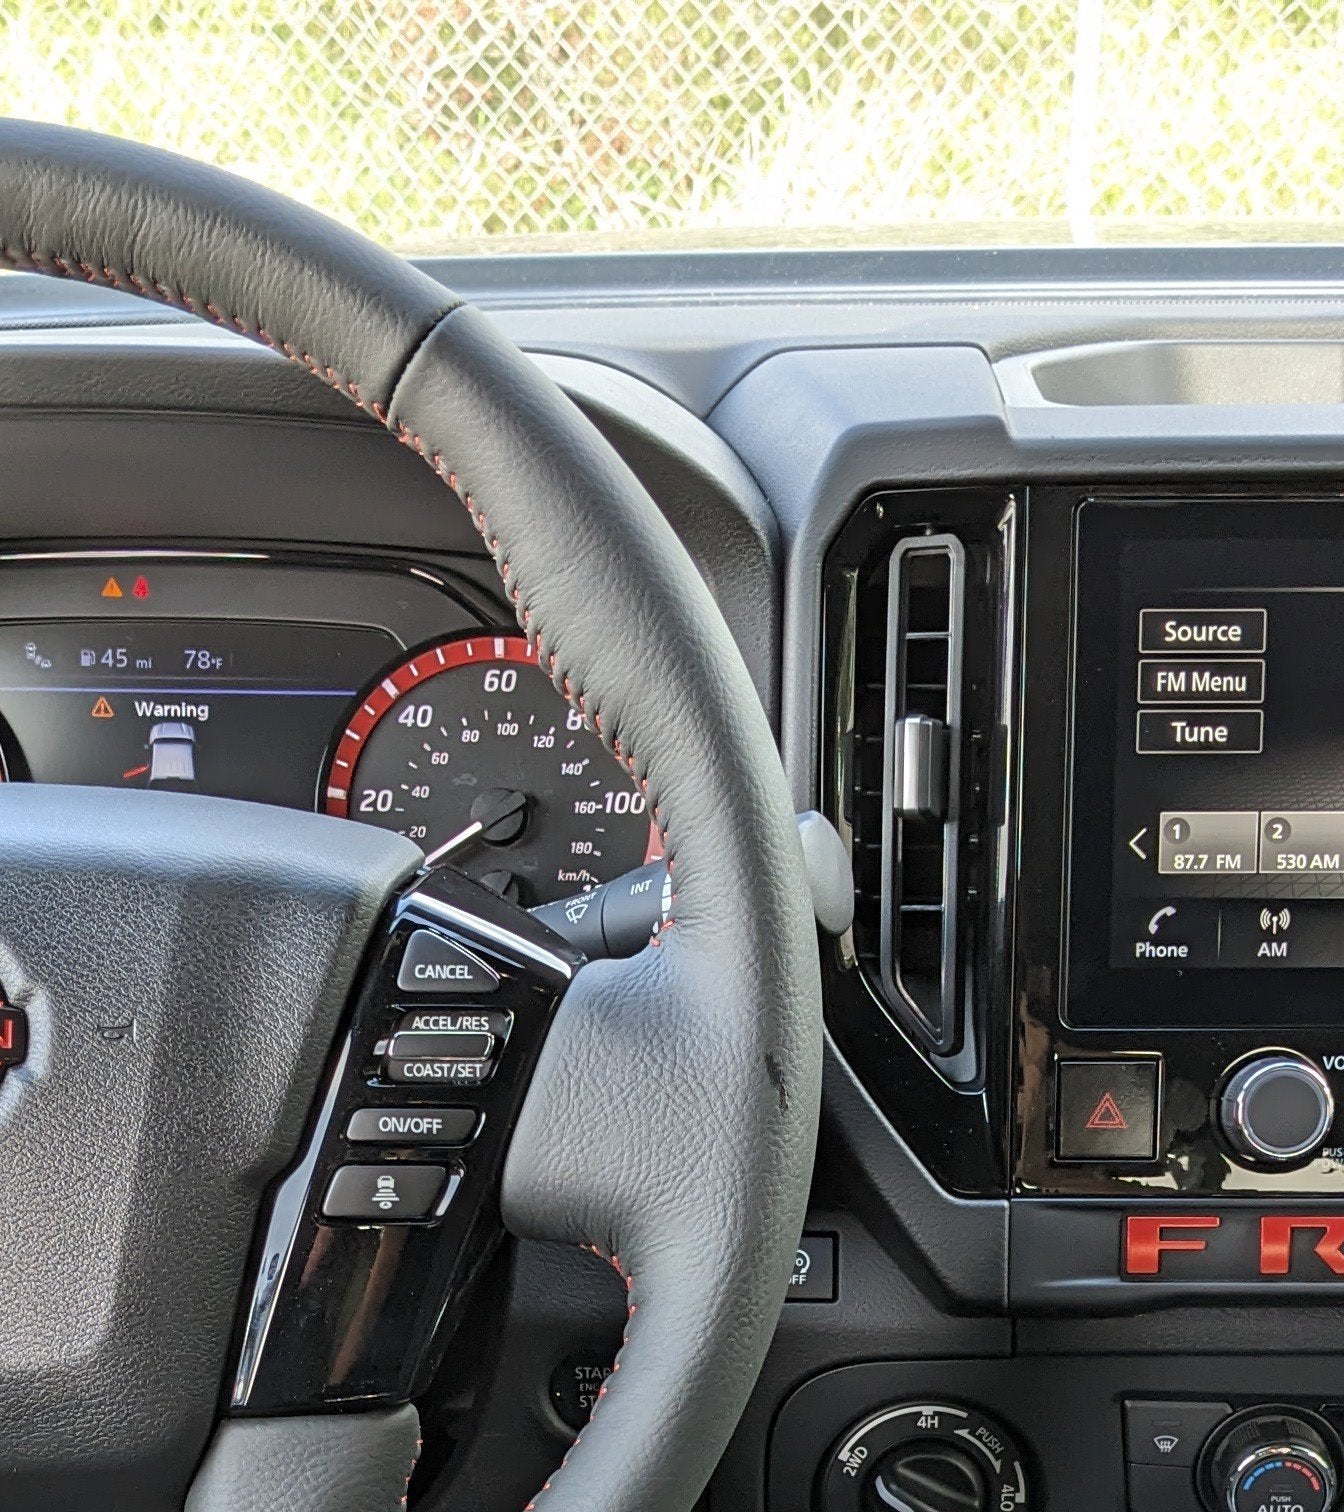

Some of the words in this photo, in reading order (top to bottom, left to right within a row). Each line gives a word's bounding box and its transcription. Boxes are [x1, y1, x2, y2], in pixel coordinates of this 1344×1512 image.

[1164, 621, 1242, 643] Source
[100, 648, 128, 669] 45
[483, 669, 517, 693] 60
[1156, 672, 1187, 693] FM
[1191, 672, 1247, 693] Menu
[134, 700, 210, 721] Warning
[398, 704, 433, 728] 40
[461, 729, 480, 743] 80
[496, 722, 519, 737] 100
[1171, 722, 1229, 743] Tune
[532, 735, 555, 749] 120
[430, 752, 449, 765] 60
[560, 762, 584, 777] 140
[411, 785, 431, 799] 40
[359, 789, 394, 813] 20
[573, 800, 597, 815] 160
[603, 791, 647, 815] 100
[408, 826, 427, 838] 20
[1171, 823, 1181, 840] 1
[1272, 823, 1283, 840] 2
[569, 841, 593, 855] 180
[1173, 853, 1209, 870] 87.7
[1215, 853, 1242, 870] FM
[1276, 853, 1308, 870] 530
[1309, 853, 1340, 870] AM
[557, 869, 591, 882] km/h
[630, 879, 653, 896] INT
[1135, 941, 1189, 960] Phone
[1256, 942, 1288, 958] AM
[414, 964, 473, 981] CANCEL
[411, 1015, 490, 1031] ACCEL/RES
[403, 1062, 483, 1079] COAST/SET
[377, 1117, 444, 1136] ON/OFF
[575, 1366, 611, 1380] STAR
[916, 1416, 939, 1429] 4H
[975, 1426, 1005, 1455] PUSH
[843, 1446, 868, 1477] 2WD
[999, 1483, 1014, 1512] 4LO
